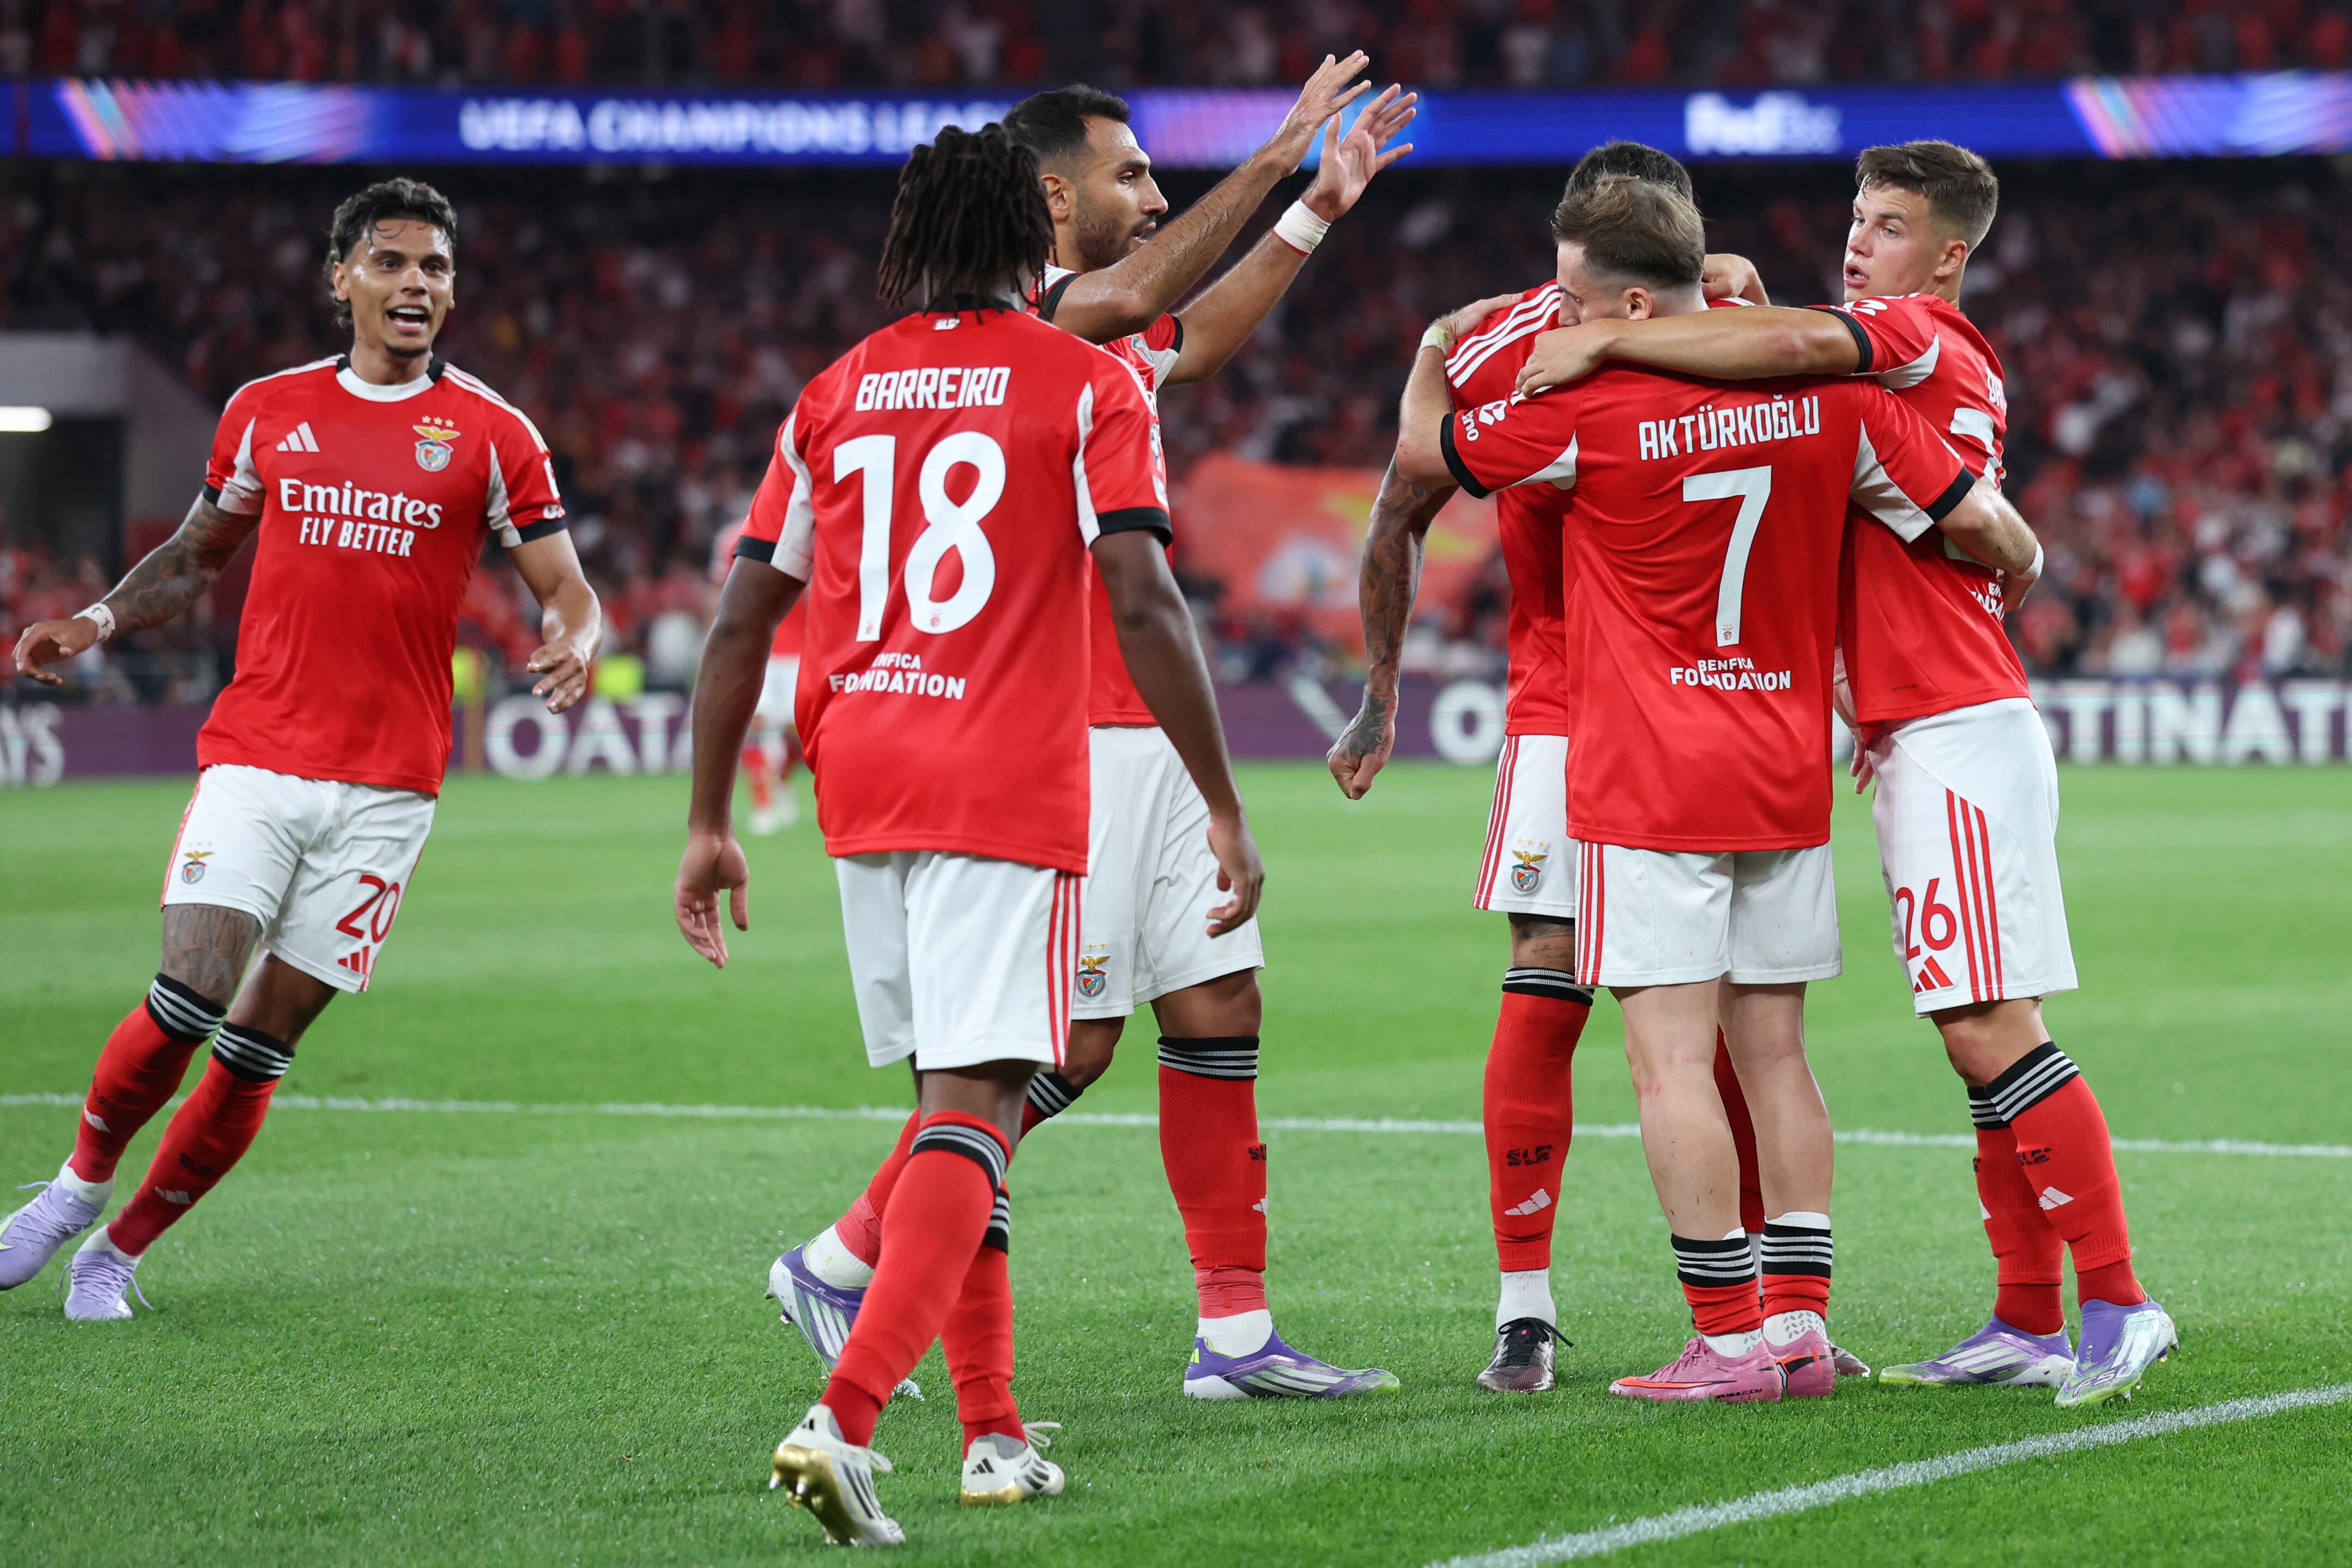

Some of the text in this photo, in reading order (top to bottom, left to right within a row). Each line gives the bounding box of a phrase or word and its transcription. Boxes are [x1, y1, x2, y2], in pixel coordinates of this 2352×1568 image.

[459, 99, 585, 151] UEFA
[587, 99, 873, 154] CHAMPIONS
[1685, 92, 1842, 155] FedEx
[855, 367, 1011, 412] BARREIRO
[1638, 393, 1820, 460] AKTÜRKOĞLU
[280, 478, 442, 529] Emirates
[299, 517, 415, 557] FLY BETTER
[833, 431, 1006, 642] 18
[1683, 465, 1772, 647] 7
[828, 670, 966, 700] FONDATION
[871, 653, 921, 670] ENFICA
[336, 874, 401, 944] 20
[1895, 877, 1957, 962] 26
